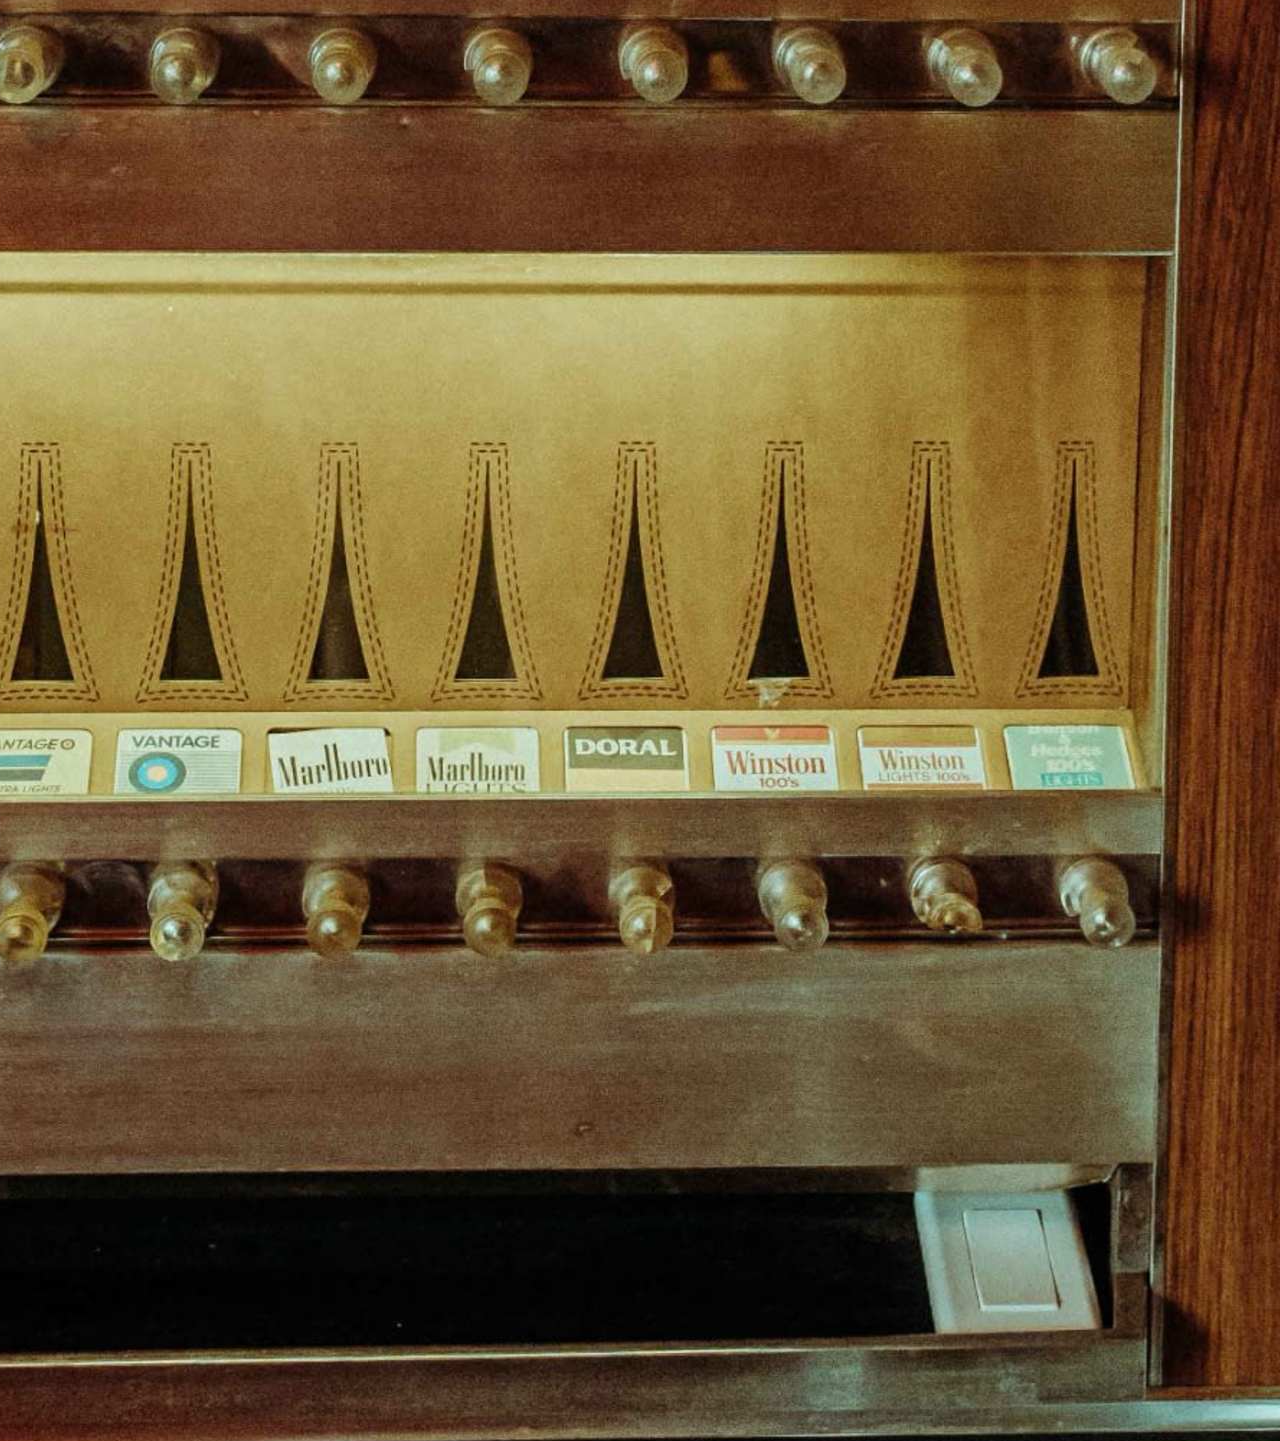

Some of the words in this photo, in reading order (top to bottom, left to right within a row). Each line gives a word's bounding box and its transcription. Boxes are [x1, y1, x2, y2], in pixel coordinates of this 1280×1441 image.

[132, 734, 221, 750] VANTAGE
[574, 737, 678, 757] DORAL
[277, 742, 388, 788] Marlboro
[427, 751, 526, 782] Marlboro
[725, 749, 827, 777] Winston
[878, 749, 965, 770] Winston
[758, 776, 800, 789] 100's
[878, 771, 931, 782] LIGHTS
